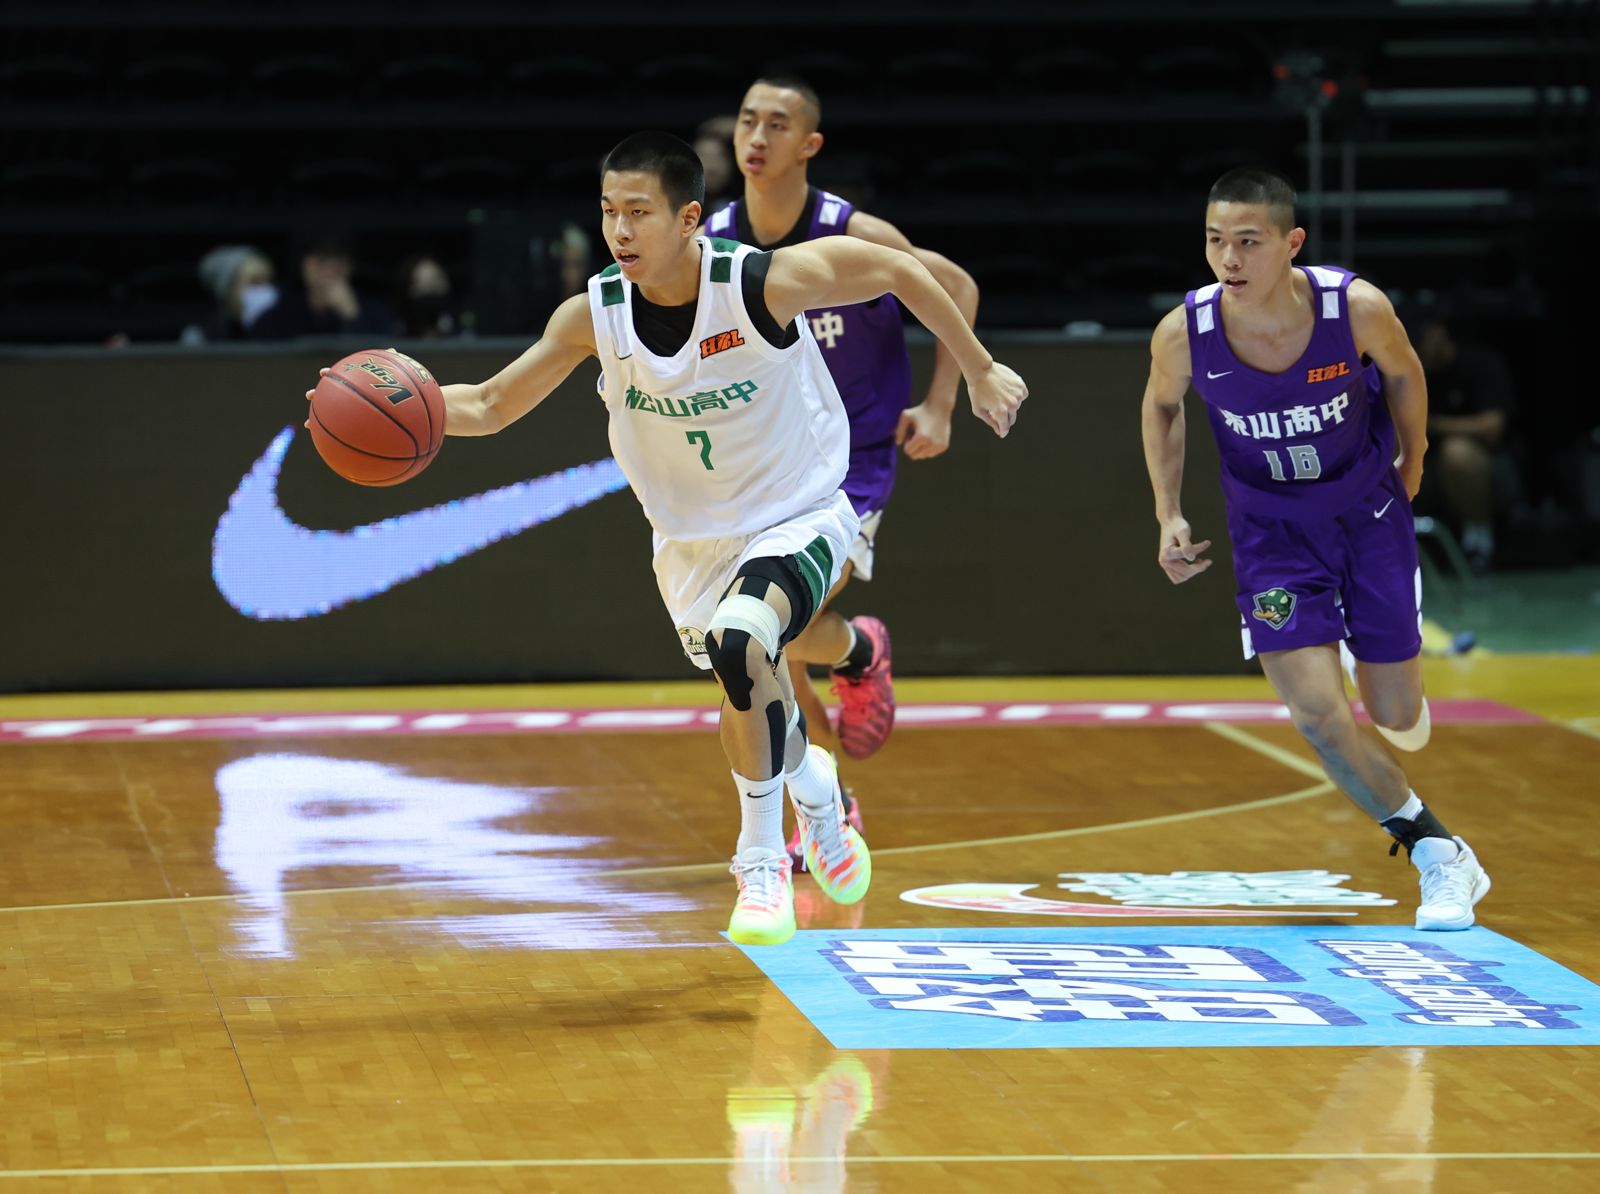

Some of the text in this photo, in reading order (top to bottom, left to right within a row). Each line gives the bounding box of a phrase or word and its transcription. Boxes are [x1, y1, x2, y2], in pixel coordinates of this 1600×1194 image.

[699, 328, 745, 360] HBL
[1307, 361, 1350, 384] HBL
[624, 379, 759, 418] 松山高中
[685, 430, 715, 471] 7
[1262, 444, 1322, 481] 16
[828, 940, 1345, 1026] 舒跑
